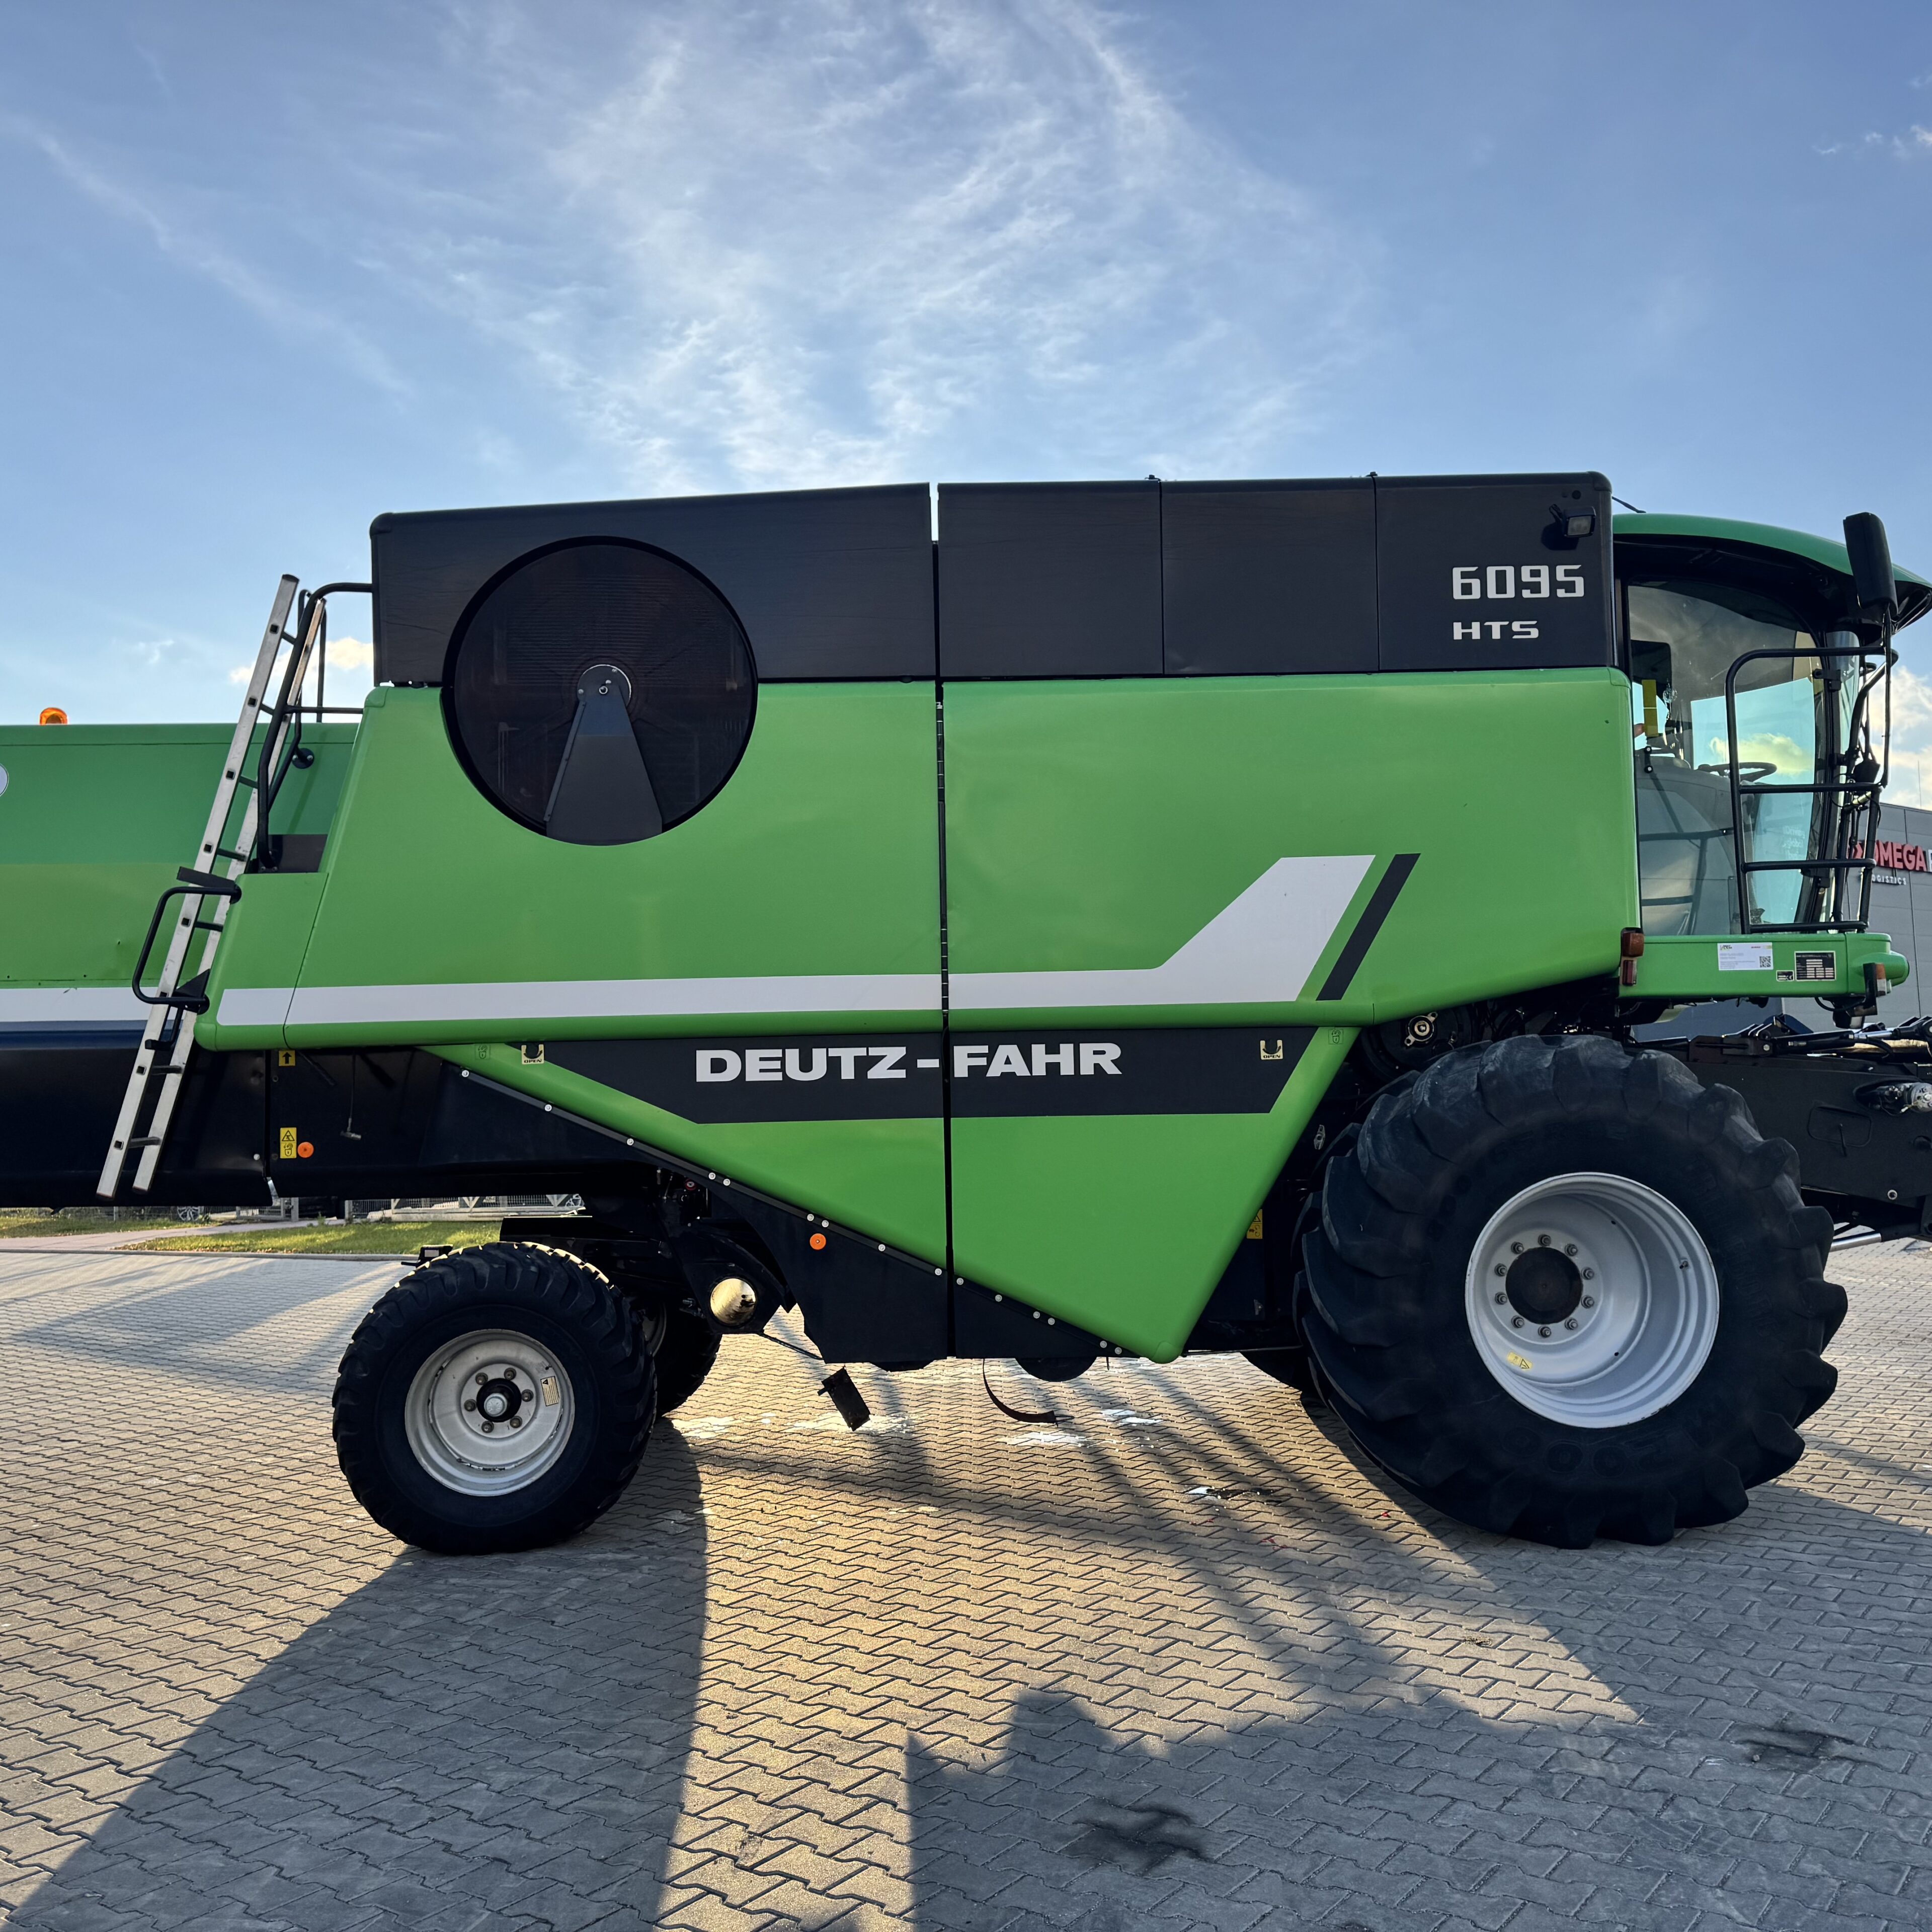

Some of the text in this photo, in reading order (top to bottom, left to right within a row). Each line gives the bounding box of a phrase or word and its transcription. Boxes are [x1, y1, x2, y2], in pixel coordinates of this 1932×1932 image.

[1453, 565, 1584, 599] 6095
[1453, 620, 1539, 640] HTS
[1871, 874, 1906, 886] OGISTICS
